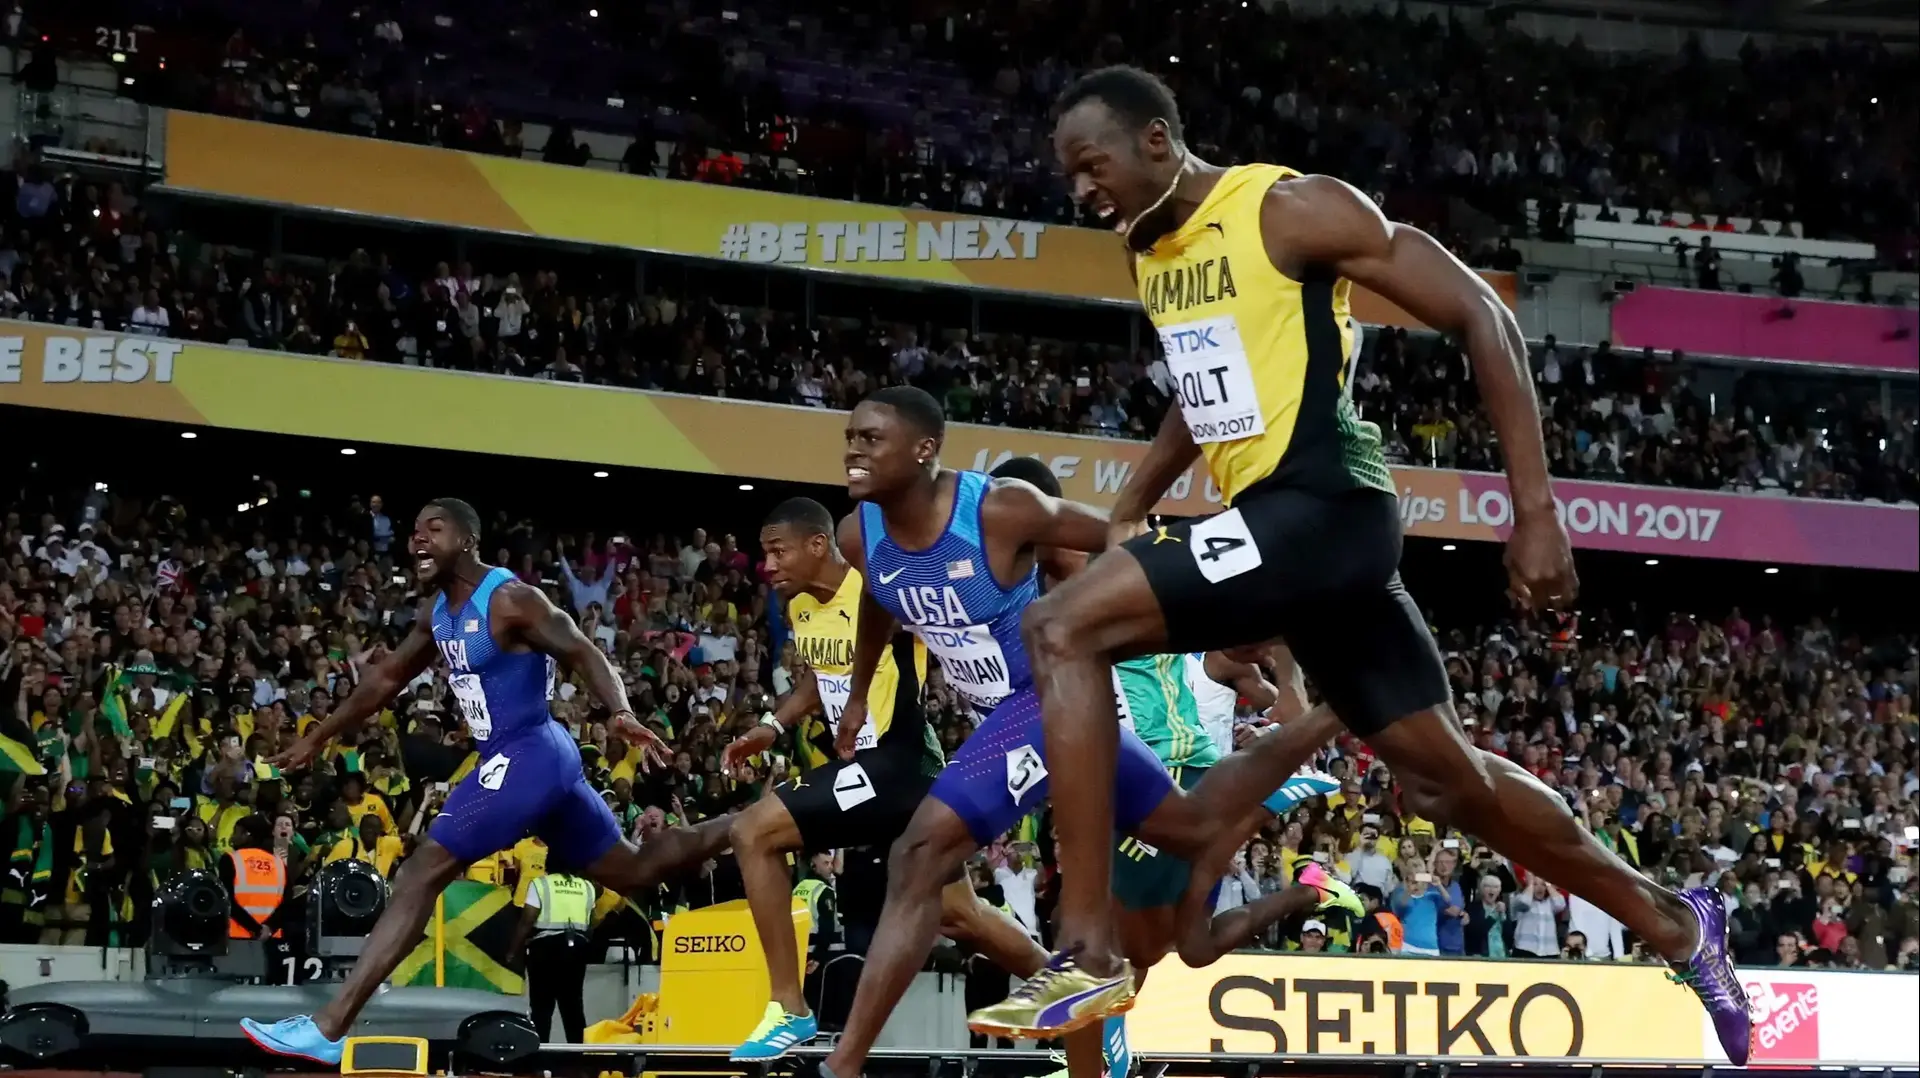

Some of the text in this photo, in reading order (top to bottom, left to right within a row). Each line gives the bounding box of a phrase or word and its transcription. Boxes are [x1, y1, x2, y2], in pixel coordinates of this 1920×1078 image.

[96, 26, 138, 53] 211
[720, 219, 1046, 262] #BE THE NEXT
[1171, 326, 1220, 353] TDK
[43, 336, 183, 383] BEST
[1192, 415, 1255, 438] NDON 2017
[1458, 488, 1629, 536] LOON
[1634, 503, 1723, 543] 2017
[1200, 537, 1247, 562] 4
[897, 585, 972, 626] USA
[924, 630, 978, 648] TDK
[436, 639, 471, 673] USA
[939, 655, 1005, 685] LEMAN
[819, 678, 850, 694] TDK
[855, 735, 873, 747] 017
[481, 763, 507, 785] 8
[836, 773, 867, 793] 7
[1009, 752, 1038, 791] 5
[553, 880, 582, 889] SAFETY
[674, 935, 746, 954] SEIKO
[1208, 975, 1584, 1057] SEIKO
[1758, 988, 1821, 1049] events
